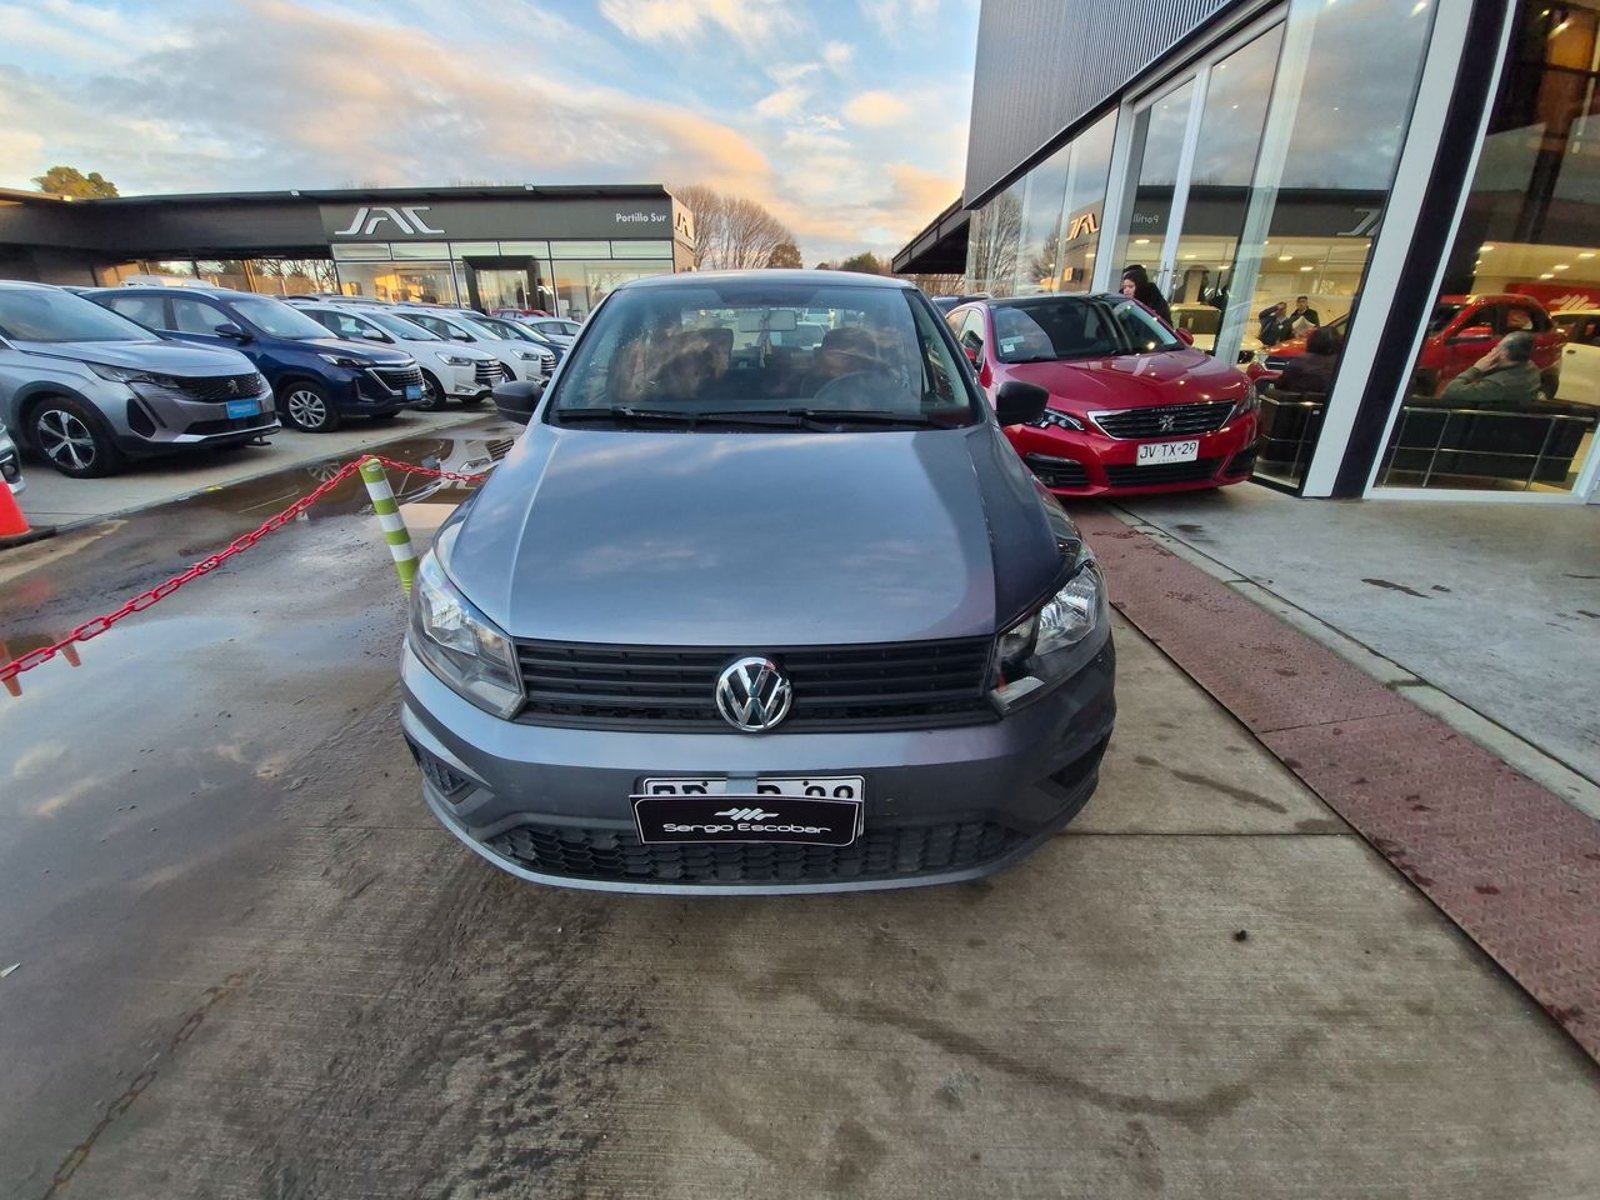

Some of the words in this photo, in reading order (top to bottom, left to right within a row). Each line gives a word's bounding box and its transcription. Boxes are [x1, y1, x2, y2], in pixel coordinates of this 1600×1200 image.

[334, 206, 446, 235] JAC
[615, 212, 649, 223] Portillo
[650, 212, 667, 222] Sur
[1139, 446, 1157, 459] JV
[1161, 444, 1177, 457] TX
[737, 823, 832, 834] Escobar
